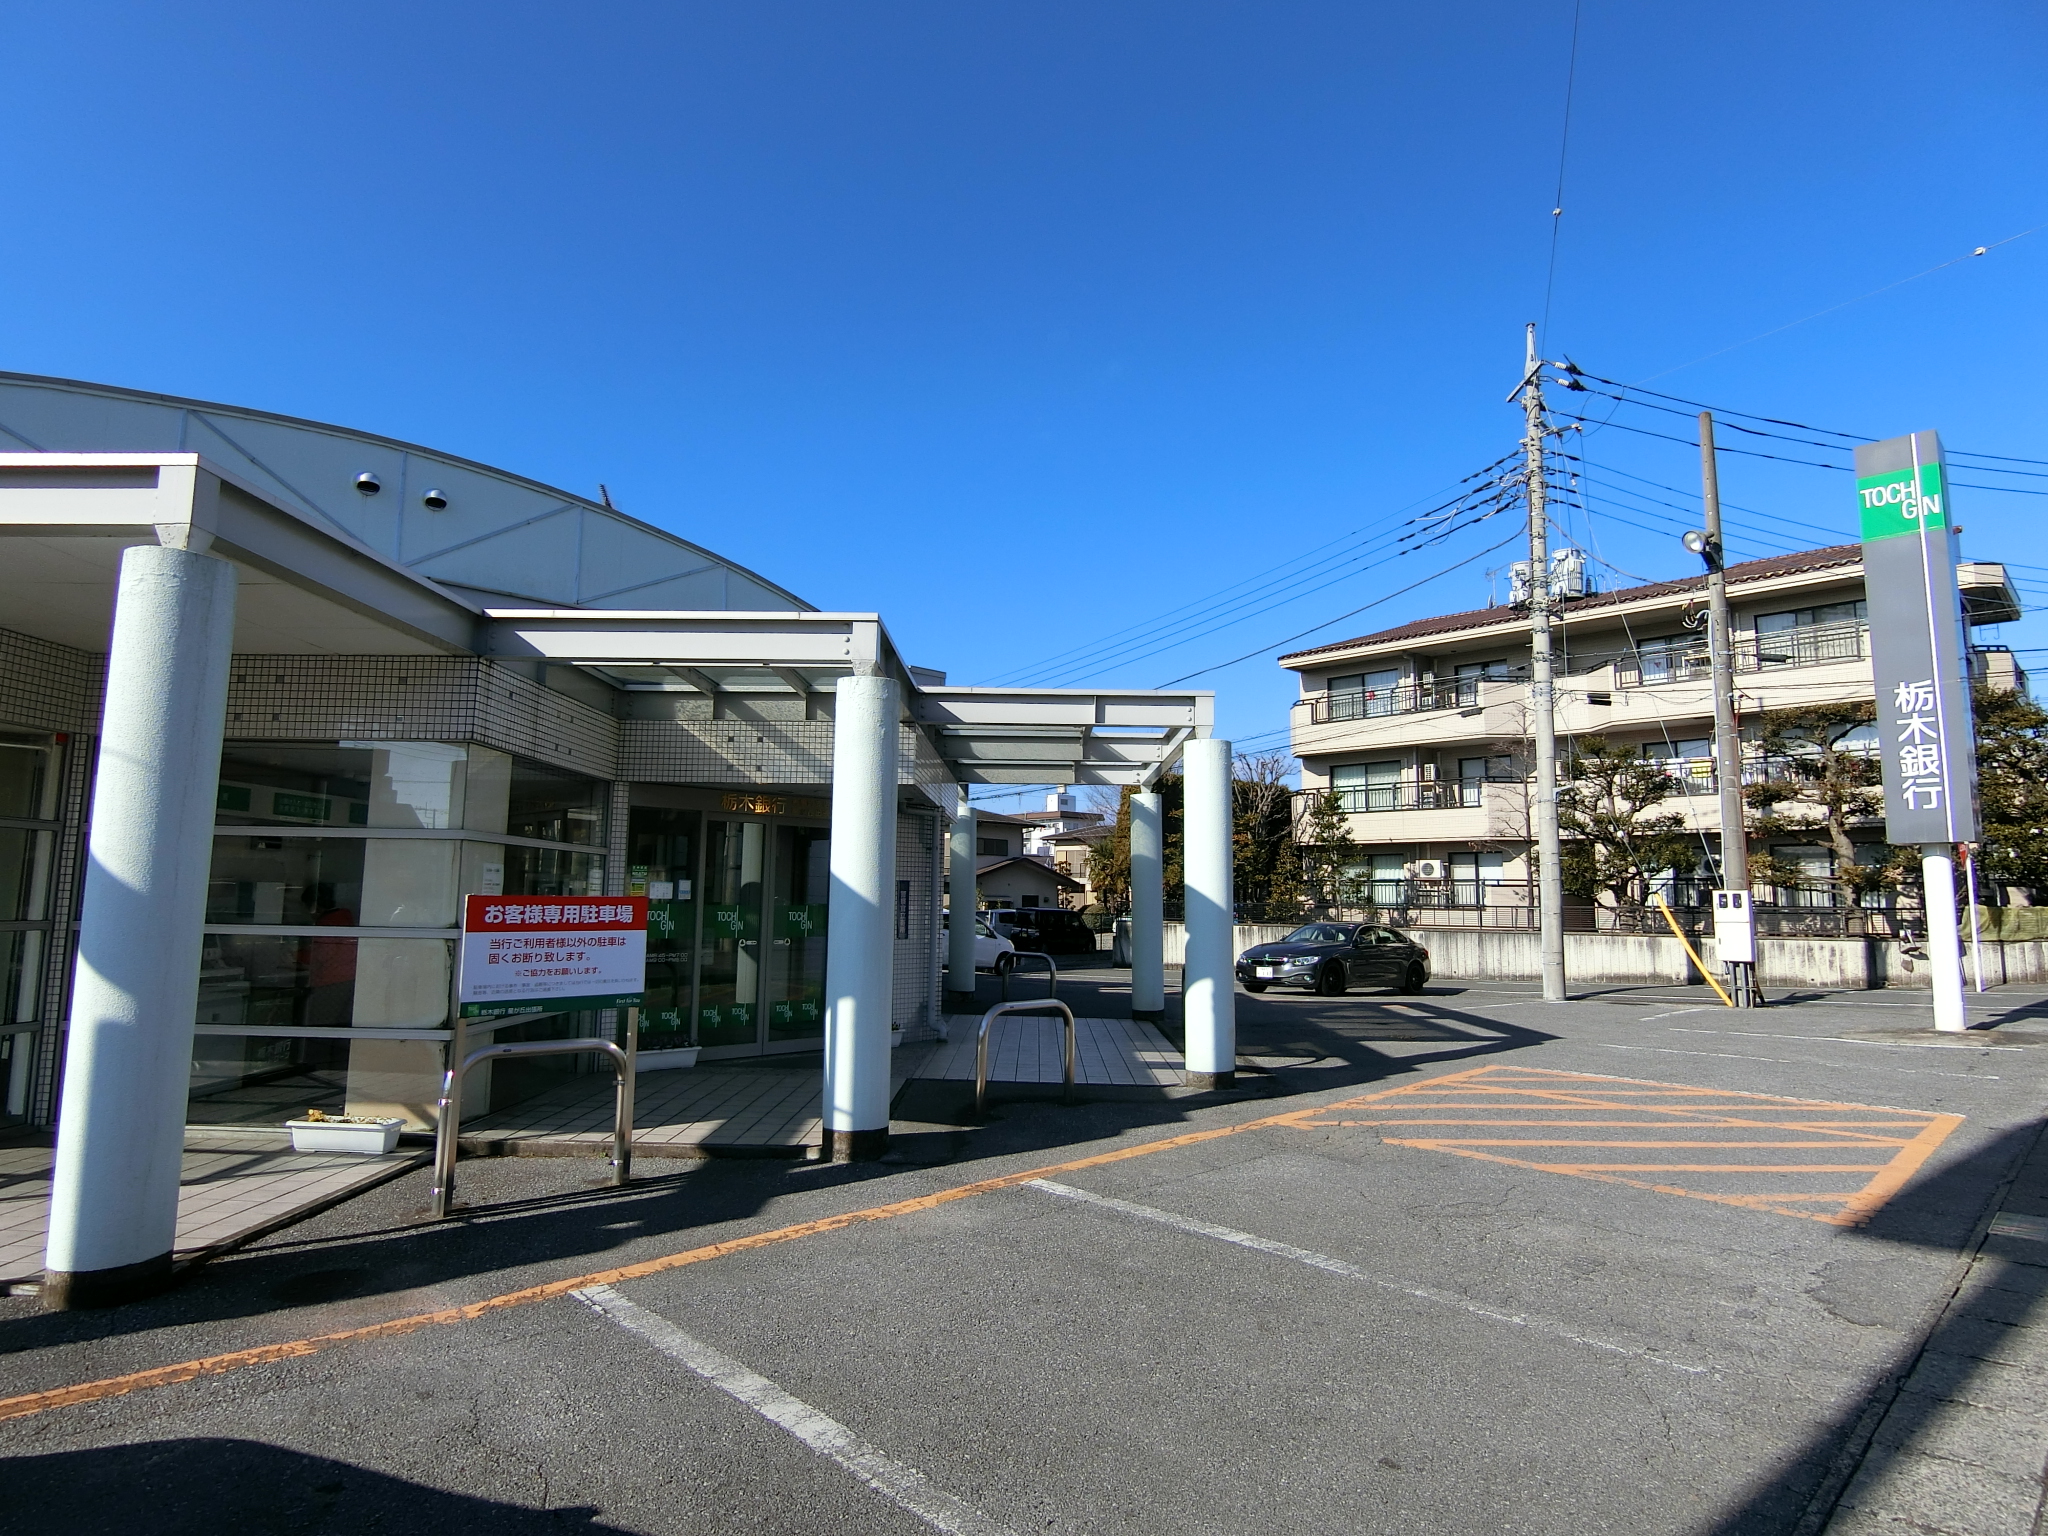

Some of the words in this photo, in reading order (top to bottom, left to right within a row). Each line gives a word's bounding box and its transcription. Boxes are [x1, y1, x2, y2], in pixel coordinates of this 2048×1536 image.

[1894, 679, 1943, 810] 栃木銀行
[721, 793, 787, 814] 栃木銀行
[484, 904, 634, 924] お客様専用駐車場
[489, 936, 627, 950] 当行ご利用者様以外の駐車は
[488, 951, 591, 965] 固くお断り致します。
